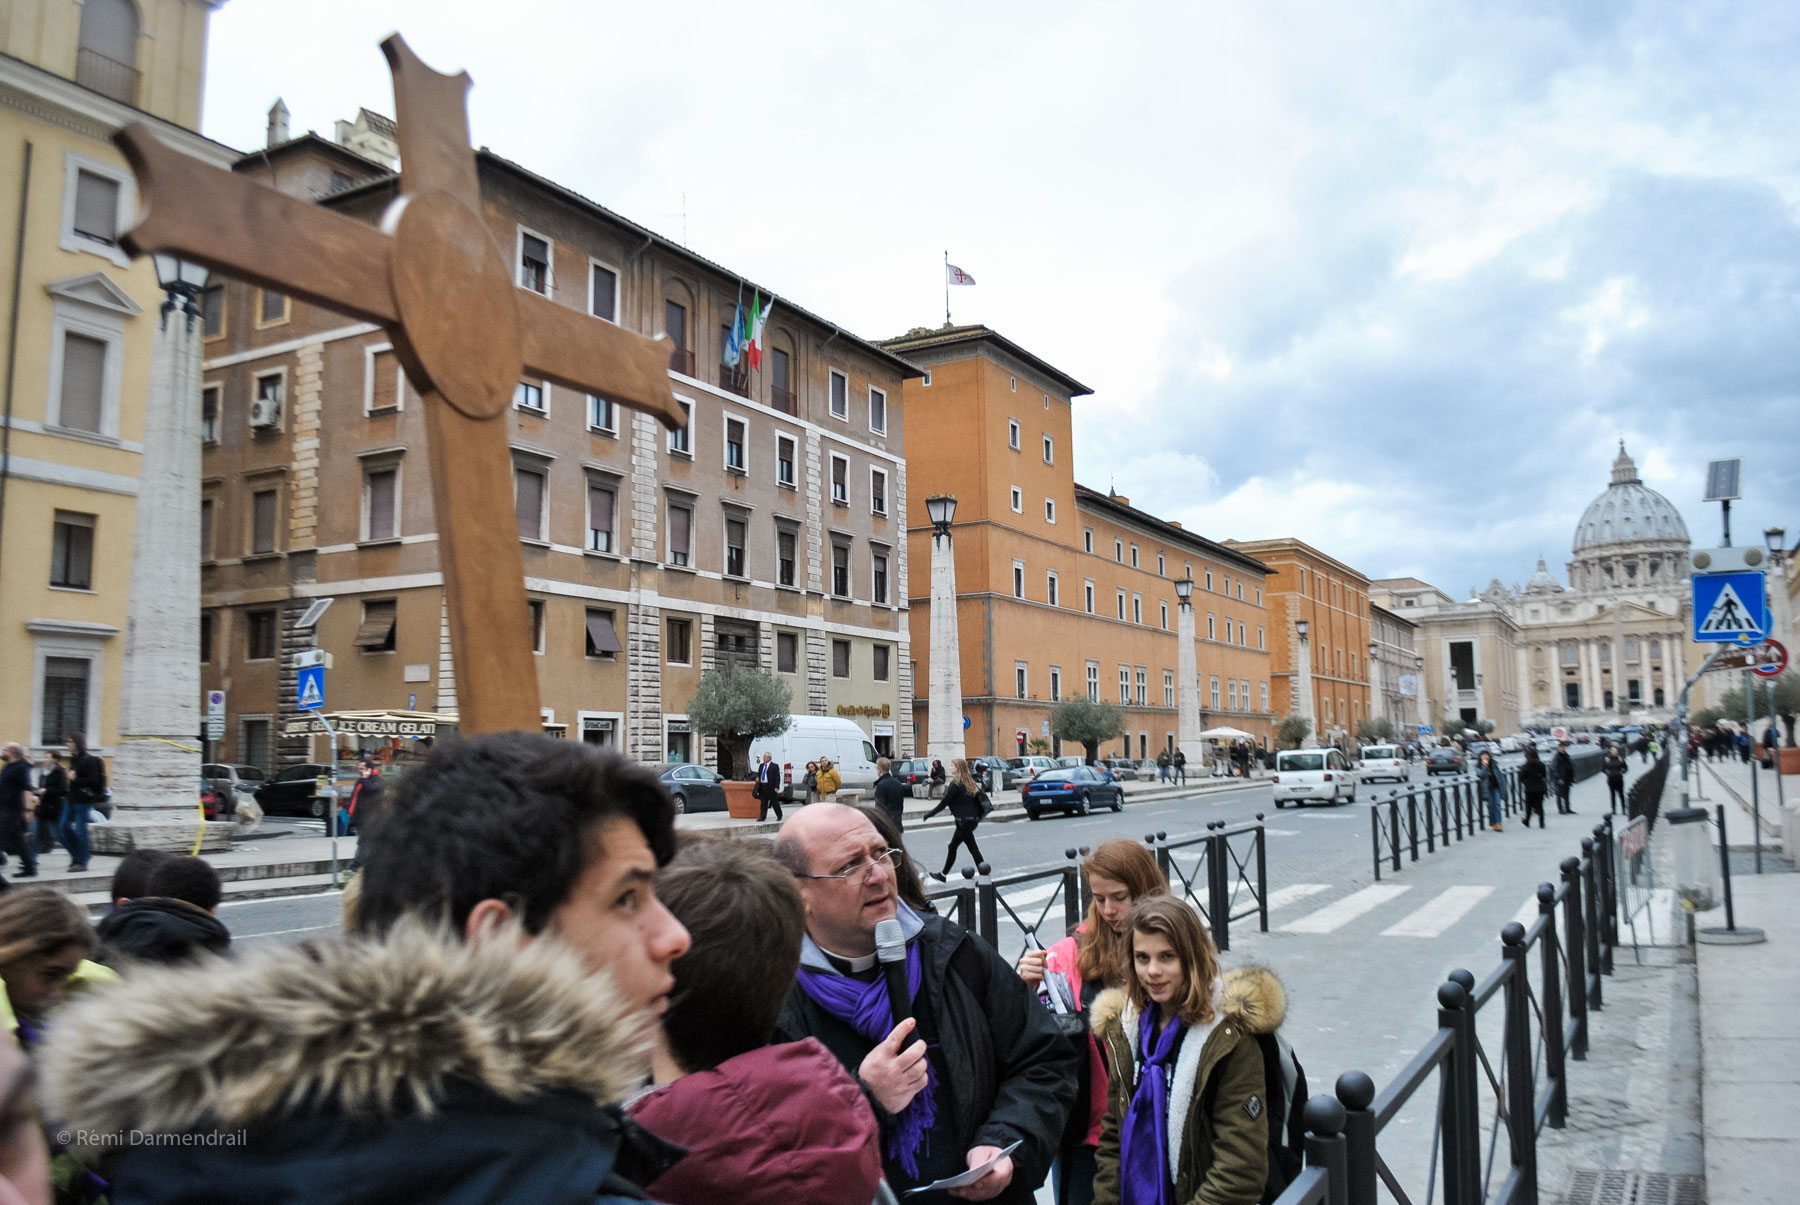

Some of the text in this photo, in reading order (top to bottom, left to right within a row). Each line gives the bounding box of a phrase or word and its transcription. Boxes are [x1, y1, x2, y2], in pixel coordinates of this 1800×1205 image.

[338, 720, 436, 734] ICE CREAM GELATI
